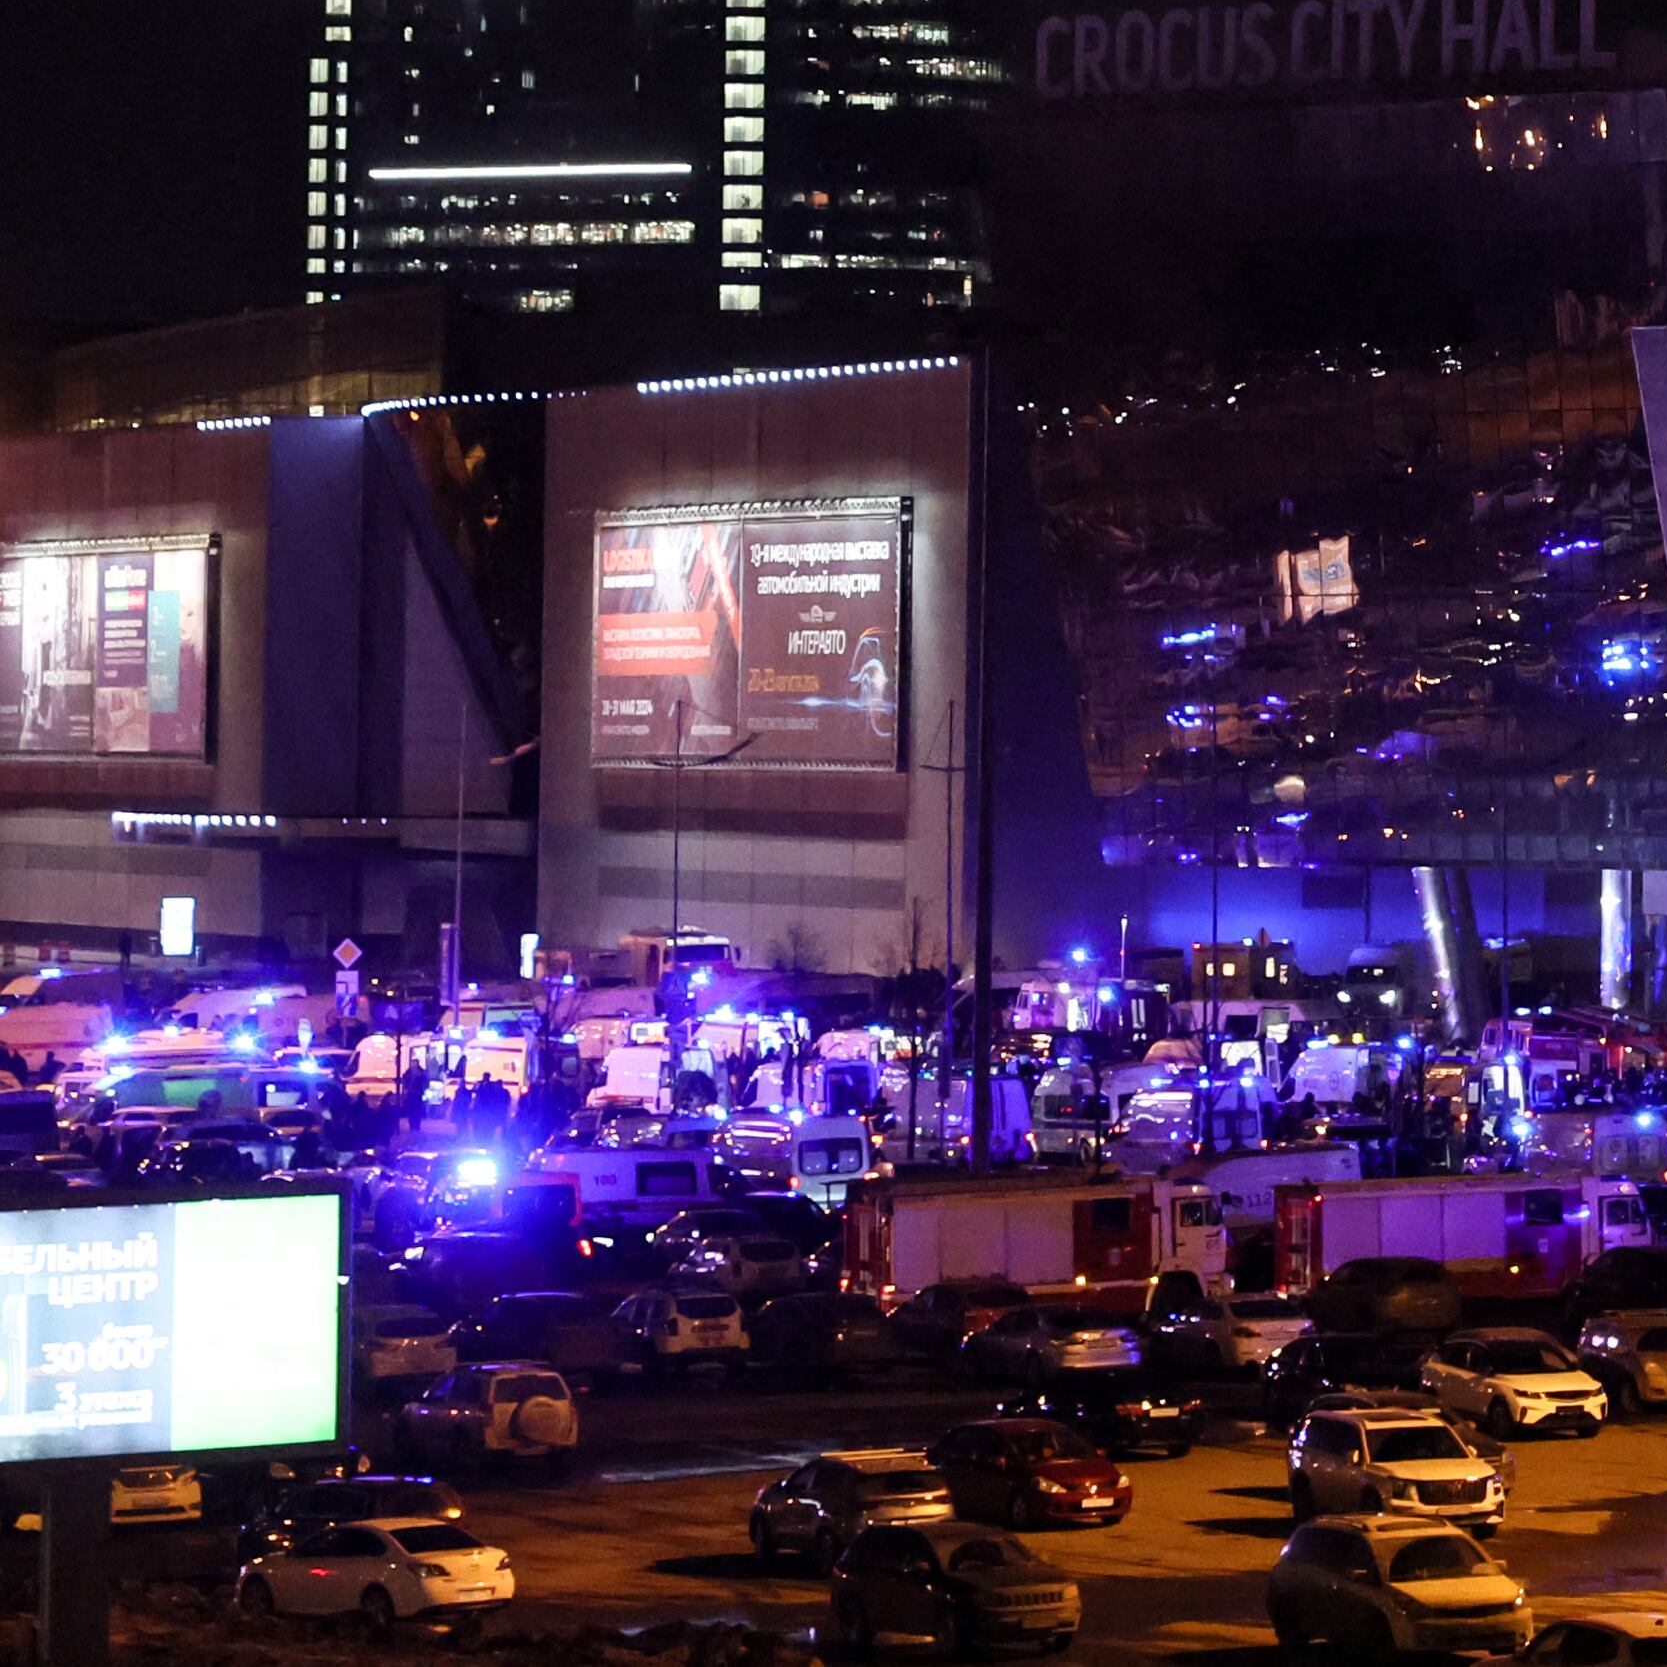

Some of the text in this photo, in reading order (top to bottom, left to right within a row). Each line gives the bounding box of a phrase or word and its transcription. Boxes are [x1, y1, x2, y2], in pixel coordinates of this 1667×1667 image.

[1034, 0, 1279, 100] CROCUS
[787, 629, 846, 654] ИНТЕРАВТО
[48, 1271, 159, 1310] ЦЕНТР
[54, 1382, 77, 1414] 3
